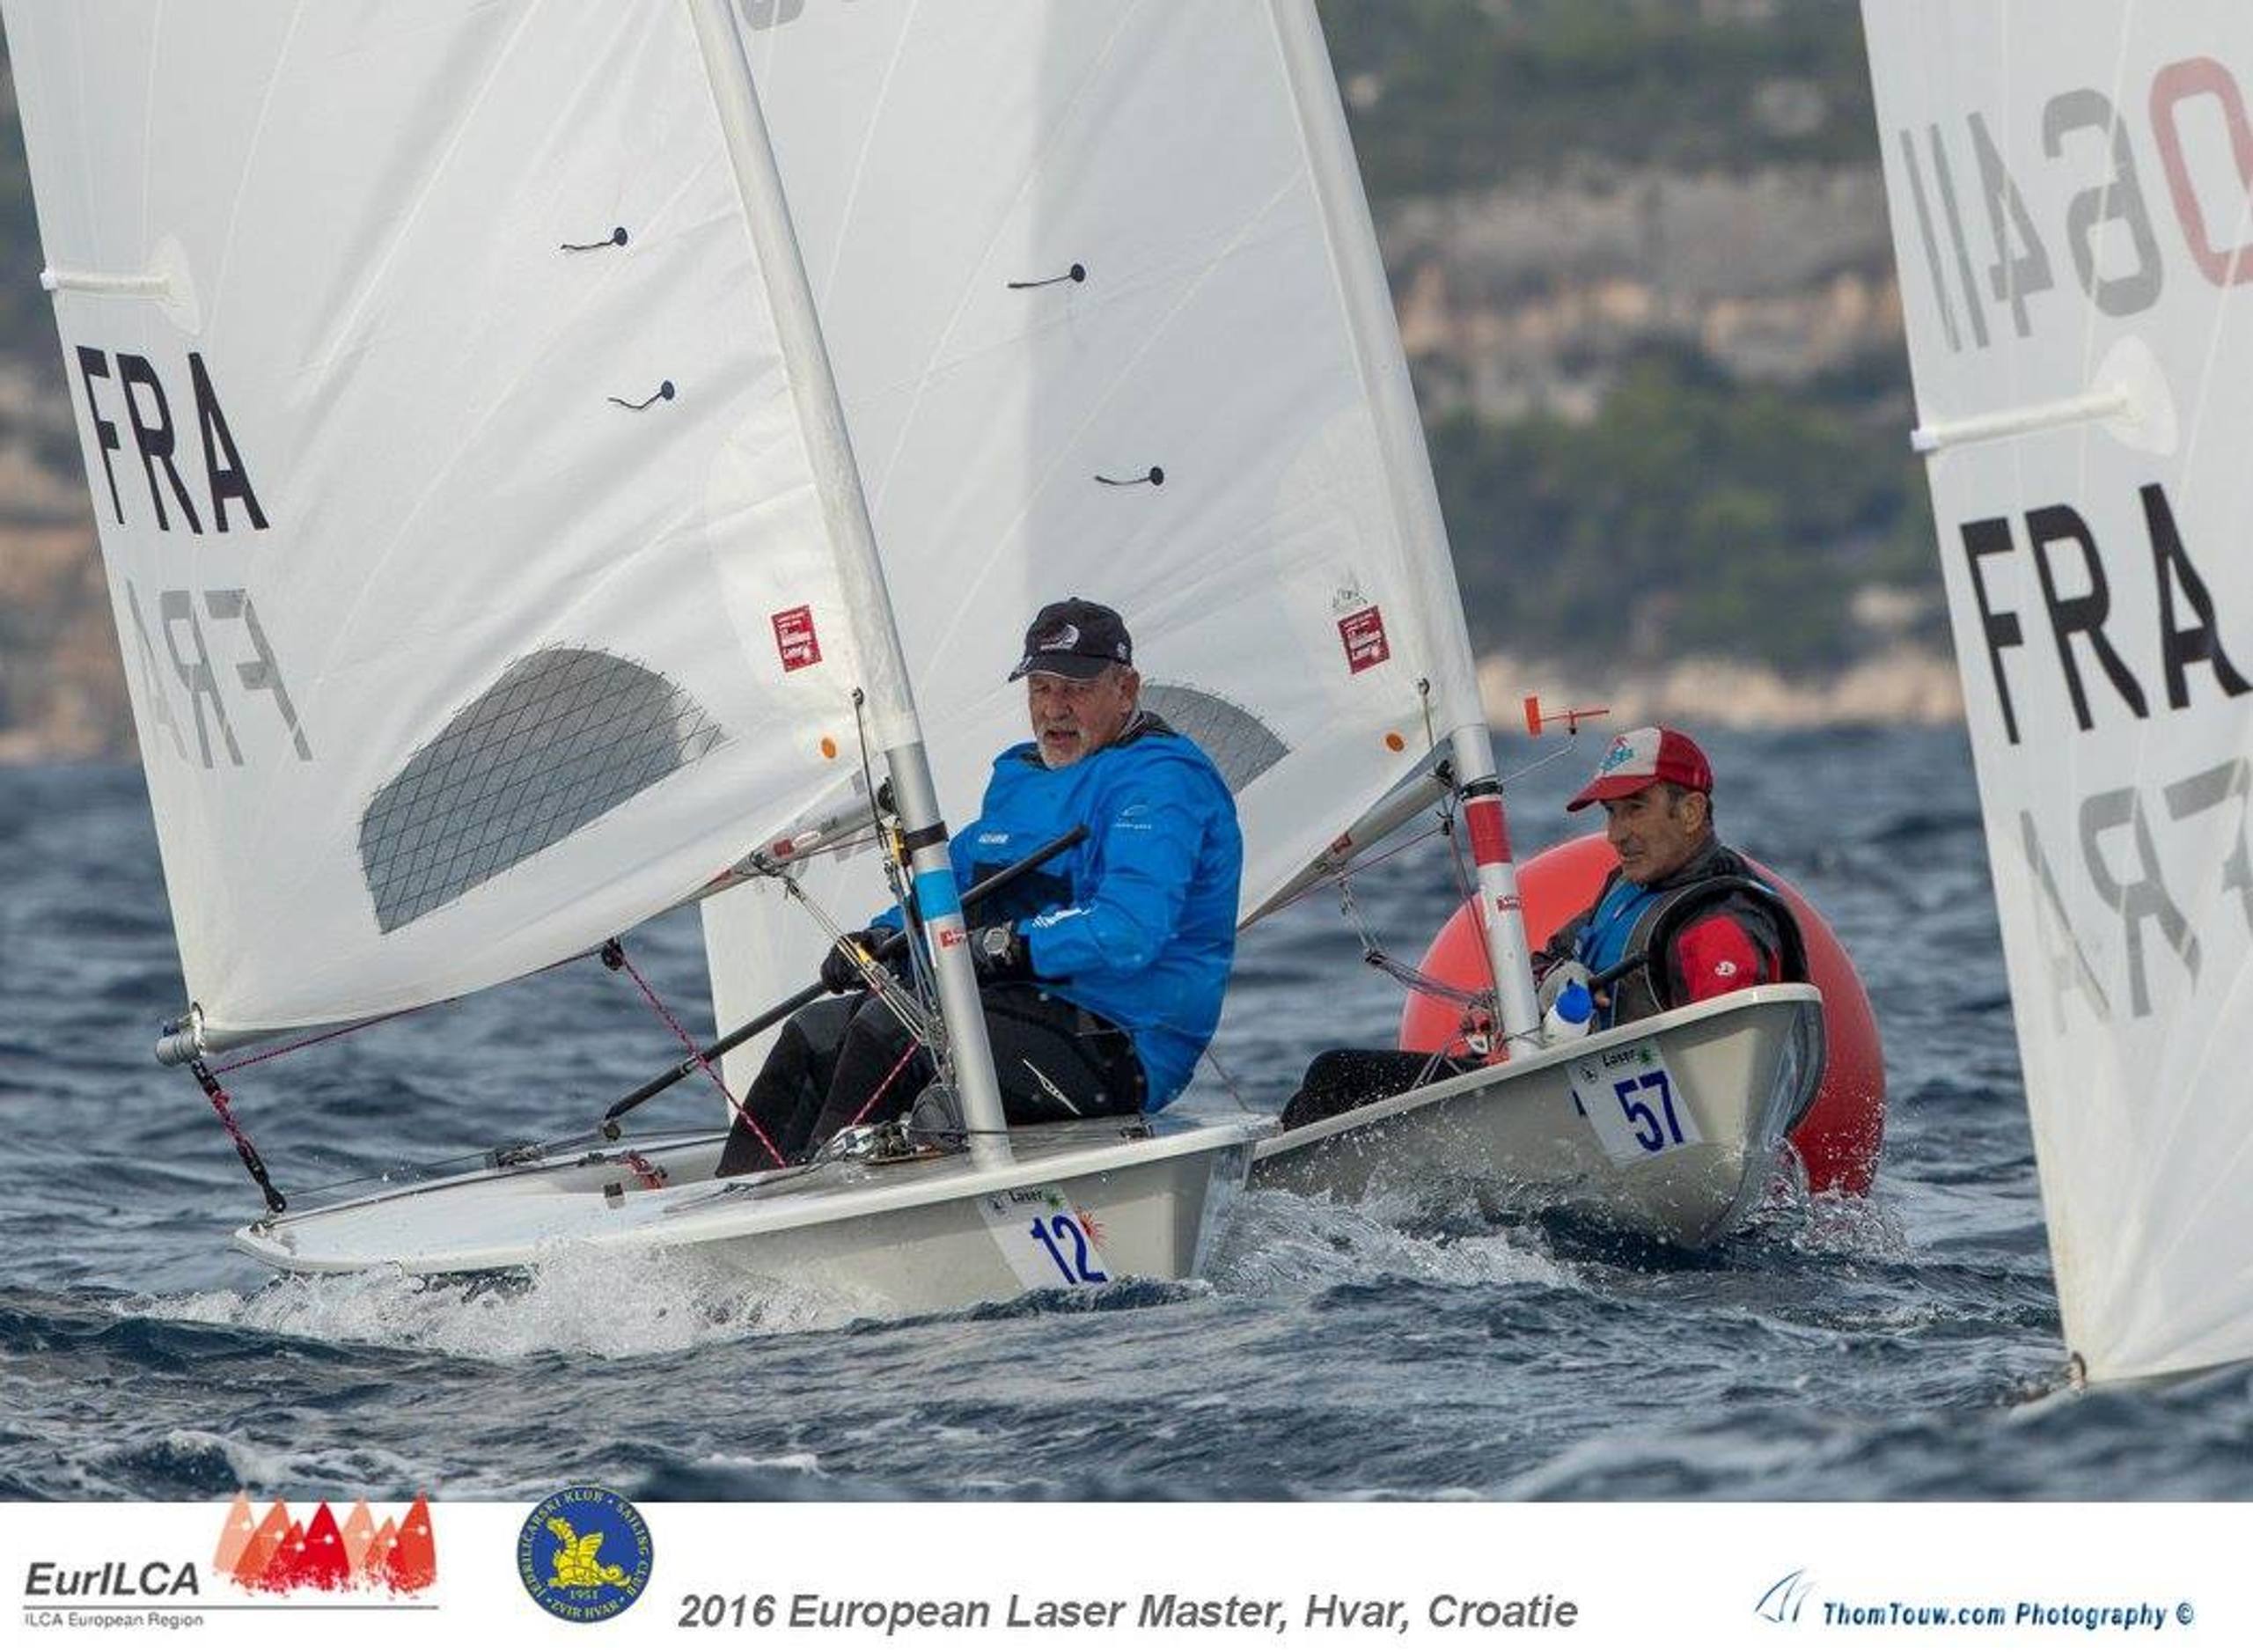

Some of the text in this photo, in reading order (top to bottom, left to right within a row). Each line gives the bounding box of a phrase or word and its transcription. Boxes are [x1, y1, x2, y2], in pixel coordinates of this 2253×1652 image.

[76, 345, 269, 534] FRA
[1959, 482, 2253, 745] FRA
[1613, 1070, 1684, 1151] 57
[1030, 1215, 1108, 1285] 12
